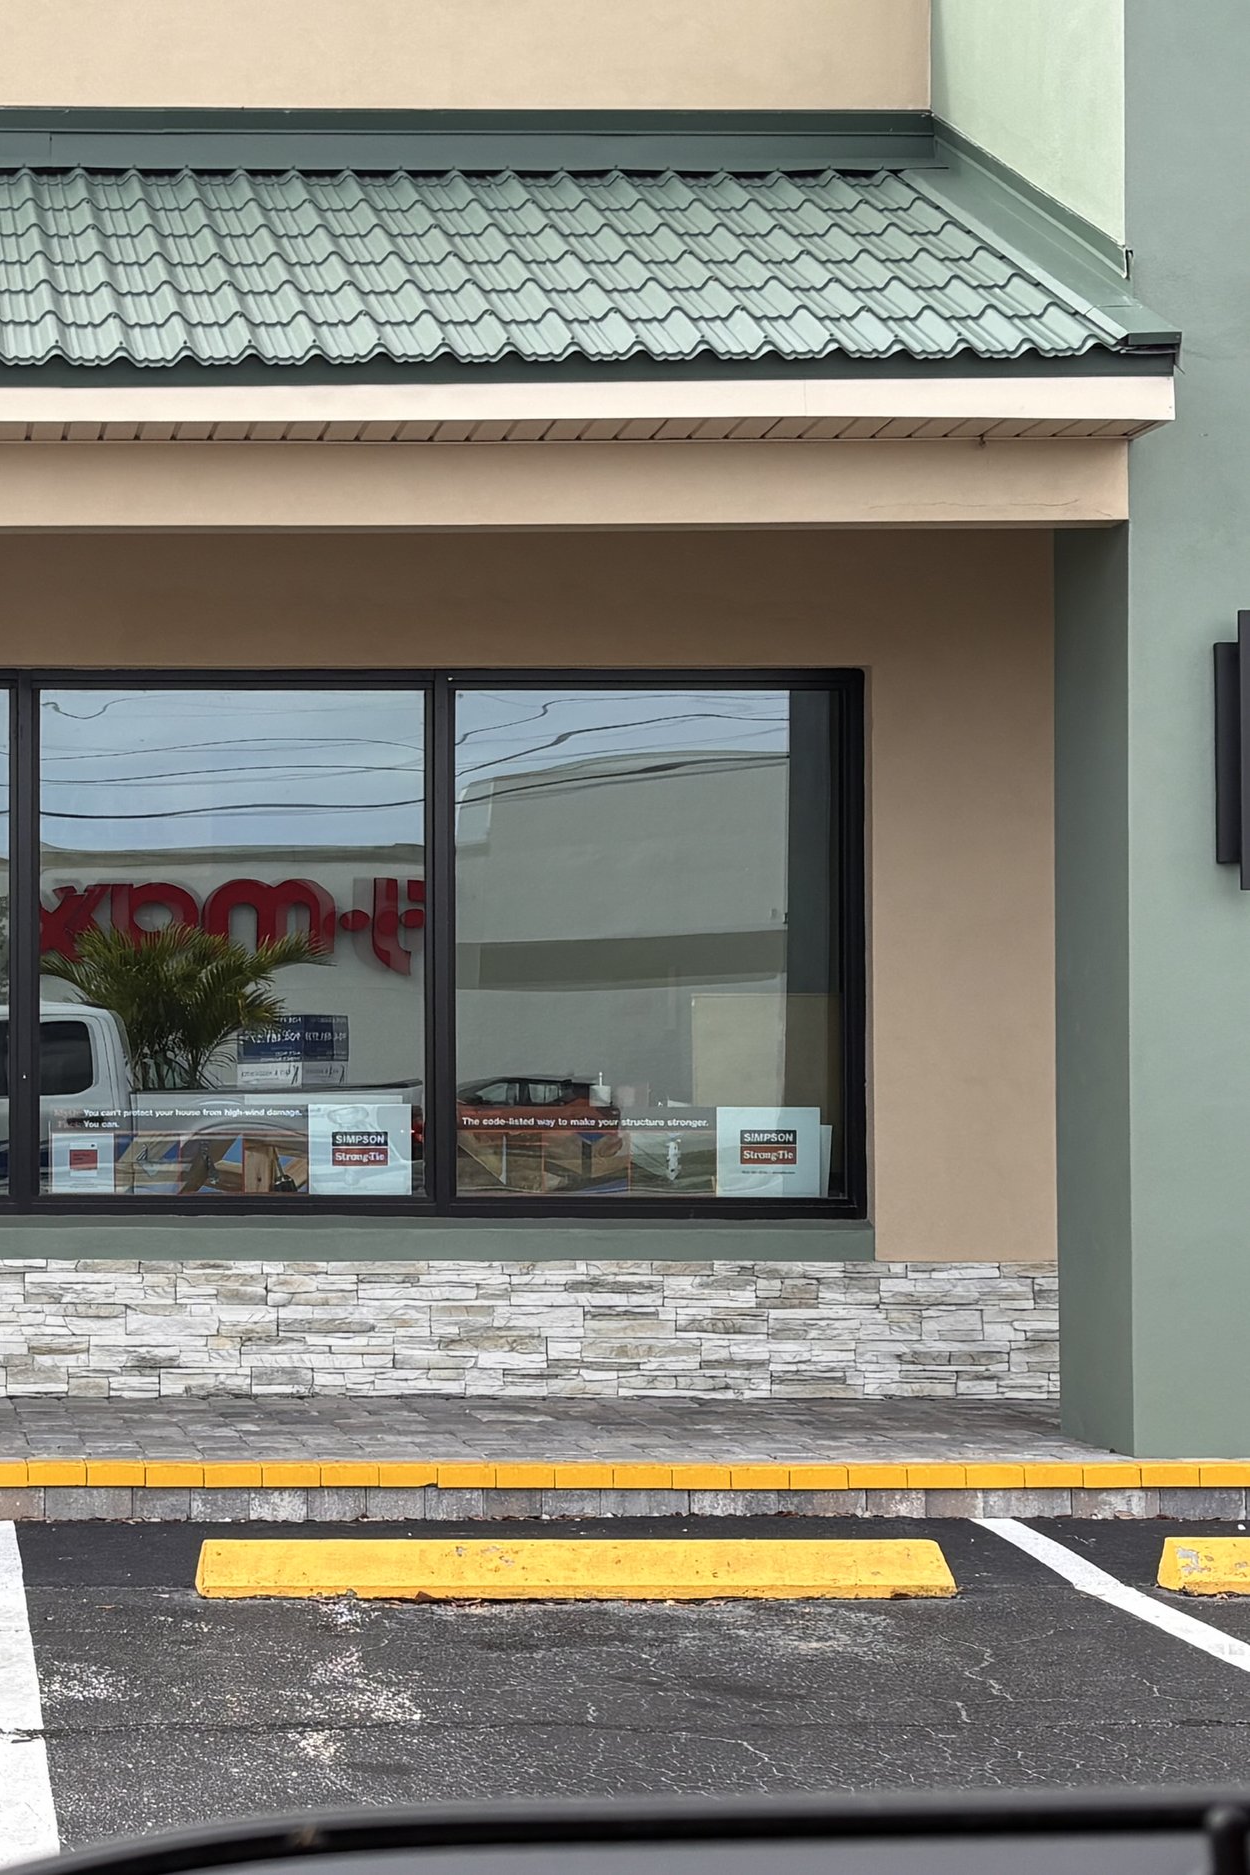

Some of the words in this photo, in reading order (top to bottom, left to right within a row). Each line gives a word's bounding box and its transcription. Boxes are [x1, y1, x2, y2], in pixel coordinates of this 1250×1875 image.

[83, 1109, 100, 1117] You
[101, 1109, 121, 1117] can't
[123, 1109, 153, 1118] protect
[155, 1110, 174, 1118] your
[224, 1109, 265, 1117] high-wind
[83, 1120, 100, 1128] You
[462, 1117, 479, 1126] The
[482, 1117, 534, 1126] code-listed
[537, 1118, 555, 1127] way
[558, 1118, 568, 1126] to
[570, 1118, 595, 1126] make
[598, 1119, 618, 1127] your
[621, 1118, 664, 1126] structure
[335, 1135, 385, 1144] SIMPSON
[743, 1133, 793, 1142] SIMPSON
